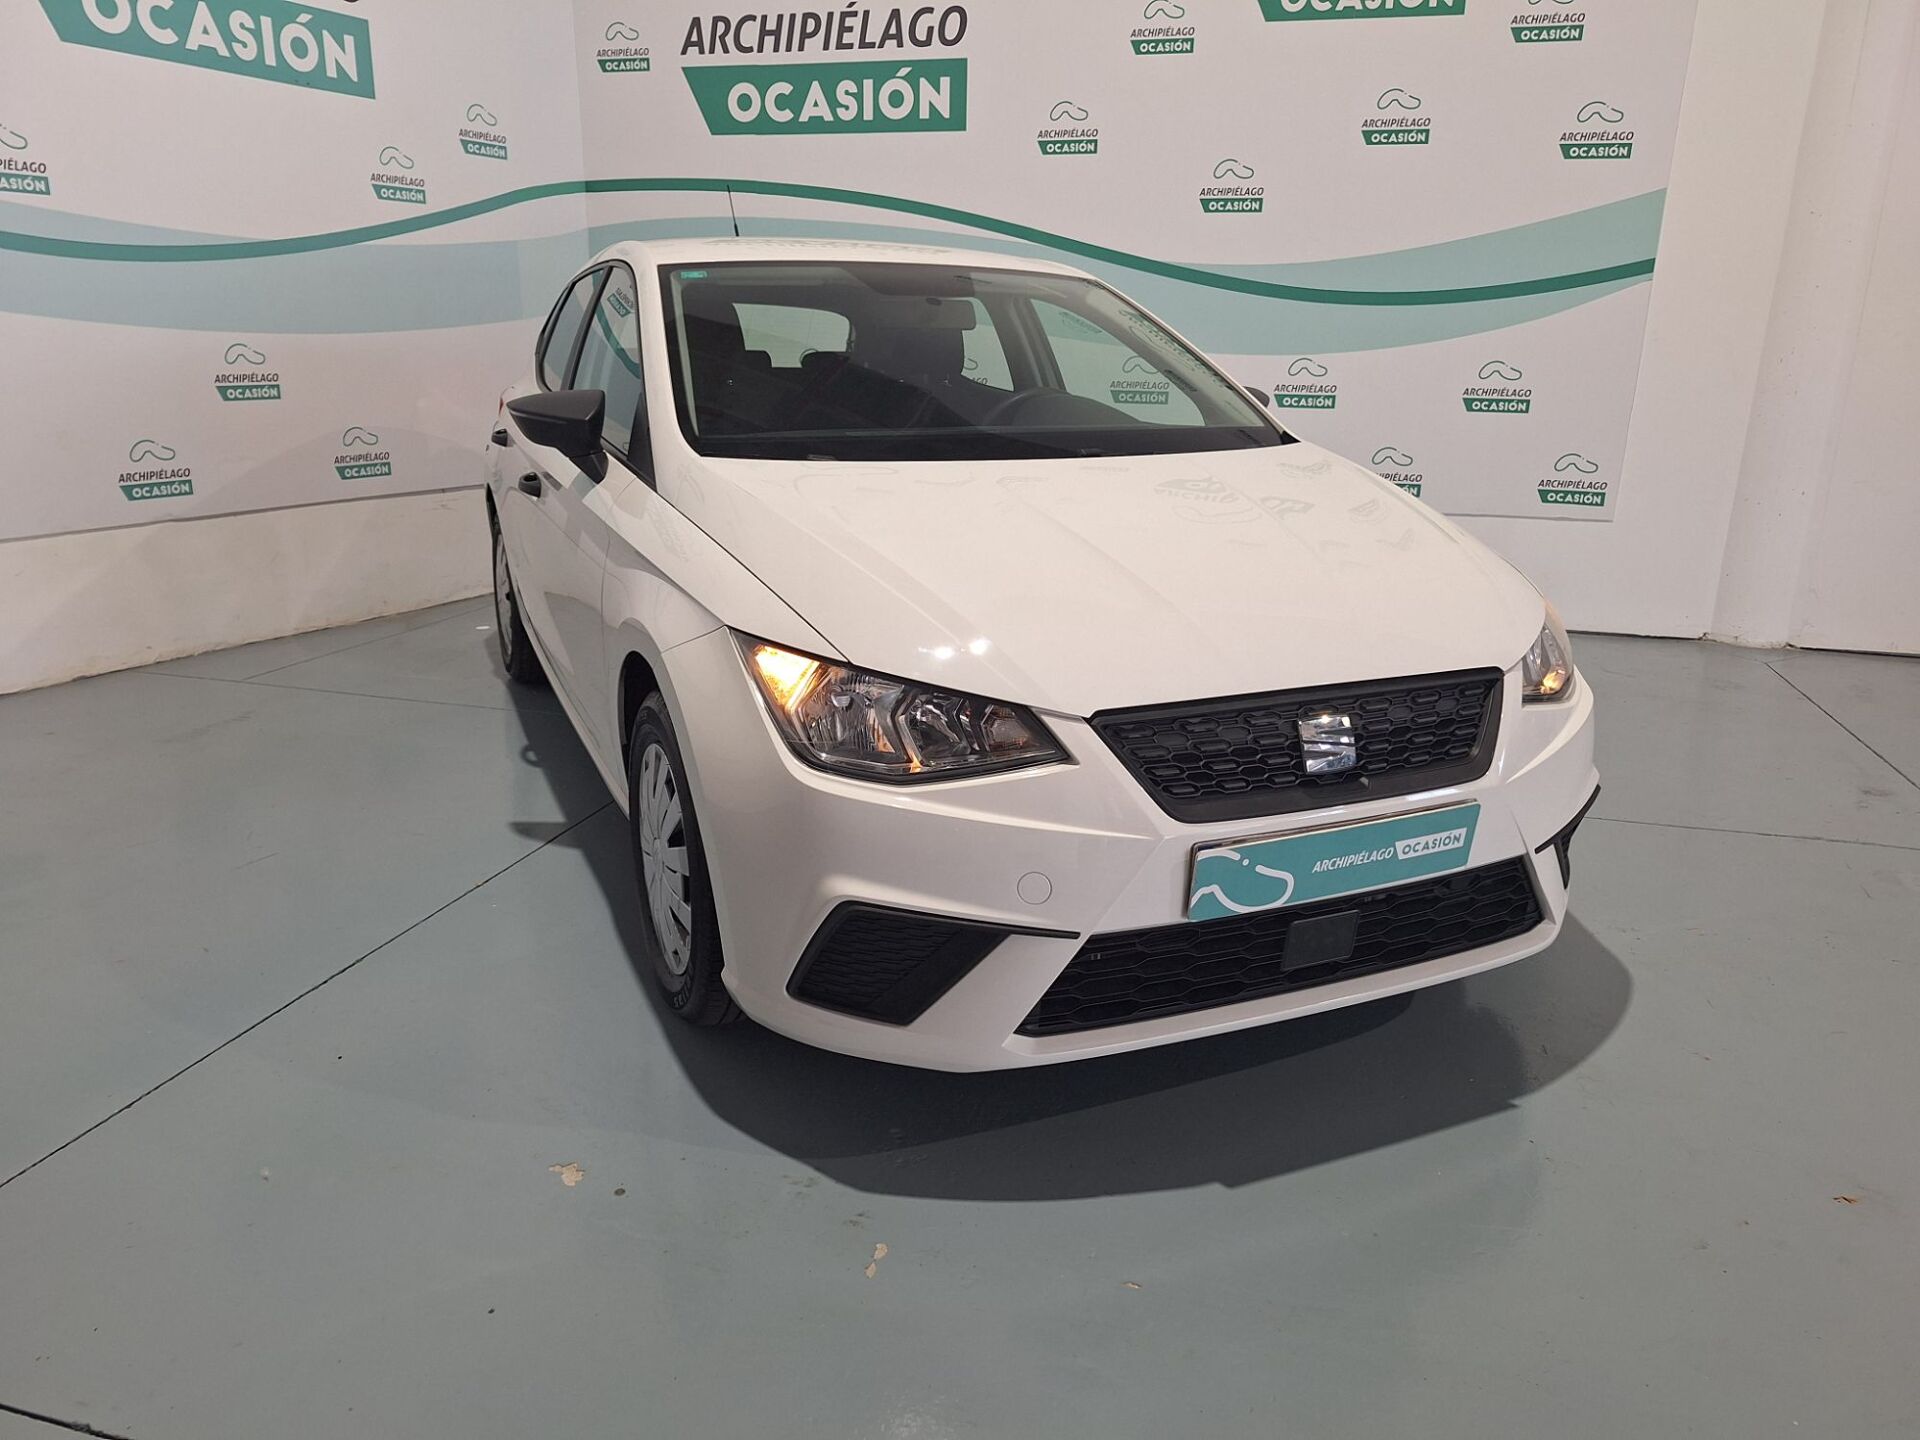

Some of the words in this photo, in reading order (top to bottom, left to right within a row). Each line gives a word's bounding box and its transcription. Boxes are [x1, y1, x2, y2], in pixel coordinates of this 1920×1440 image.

[1511, 12, 1586, 26] ARCHIPIÉLAGO
[680, 1, 968, 55] ARCHIPIÉLAGO
[1130, 26, 1195, 38] ARCHIPIÉLAGO
[1520, 26, 1579, 40] OCASIÓN
[82, 0, 358, 82] OCASIÓN
[1139, 40, 1192, 53] OCASIÓN
[597, 47, 650, 58] ARCHIPIÉLAGO
[605, 60, 648, 71] OCASIÓN
[727, 67, 951, 122] OCASIÓN
[1361, 117, 1431, 130] ARCHIPIÉLAGO
[458, 129, 507, 145] ARCHIPIÉLAGO
[1038, 128, 1099, 140] ARCHIPIÉLAGO
[1371, 130, 1425, 144] OCASIÓN
[1559, 130, 1634, 143] ARCHIPIÉLAGO
[467, 143, 505, 158] OCASIÓN
[1046, 140, 1096, 153] OCASIÓN
[1569, 144, 1629, 158] OCASIÓN
[370, 173, 425, 188] ARCHIPIÉLAGO
[380, 188, 424, 202] OCASIÓN
[1199, 185, 1264, 198] ARCHIPIÉLAGO
[1208, 199, 1260, 212] OCASIÓN
[214, 372, 279, 385] ARCHIPIÉLAGO
[226, 386, 278, 399] OCASIÓN
[1110, 381, 1170, 391] ARCHIPIÉLAGO
[1274, 383, 1337, 395] ARCHIPIÉLAGO
[1118, 392, 1166, 403] OCASIÓN
[1462, 387, 1532, 399] ARCHIPIÉLAGO
[1282, 395, 1333, 408] OCASIÓN
[1471, 399, 1527, 412] OCASIÓN
[334, 451, 390, 465] ARCHIPIÉLAGO
[118, 467, 191, 484] ARCHIPIÉLAGO
[345, 464, 389, 477] OCASIÓN
[132, 482, 190, 497] OCASIÓN
[1537, 478, 1608, 491] ARCHIPIÉLAGO
[1547, 490, 1602, 504] OCASIÓN
[1312, 848, 1394, 874] ARCHIPIÉLAGO
[1402, 832, 1462, 856] OCASIÓN
